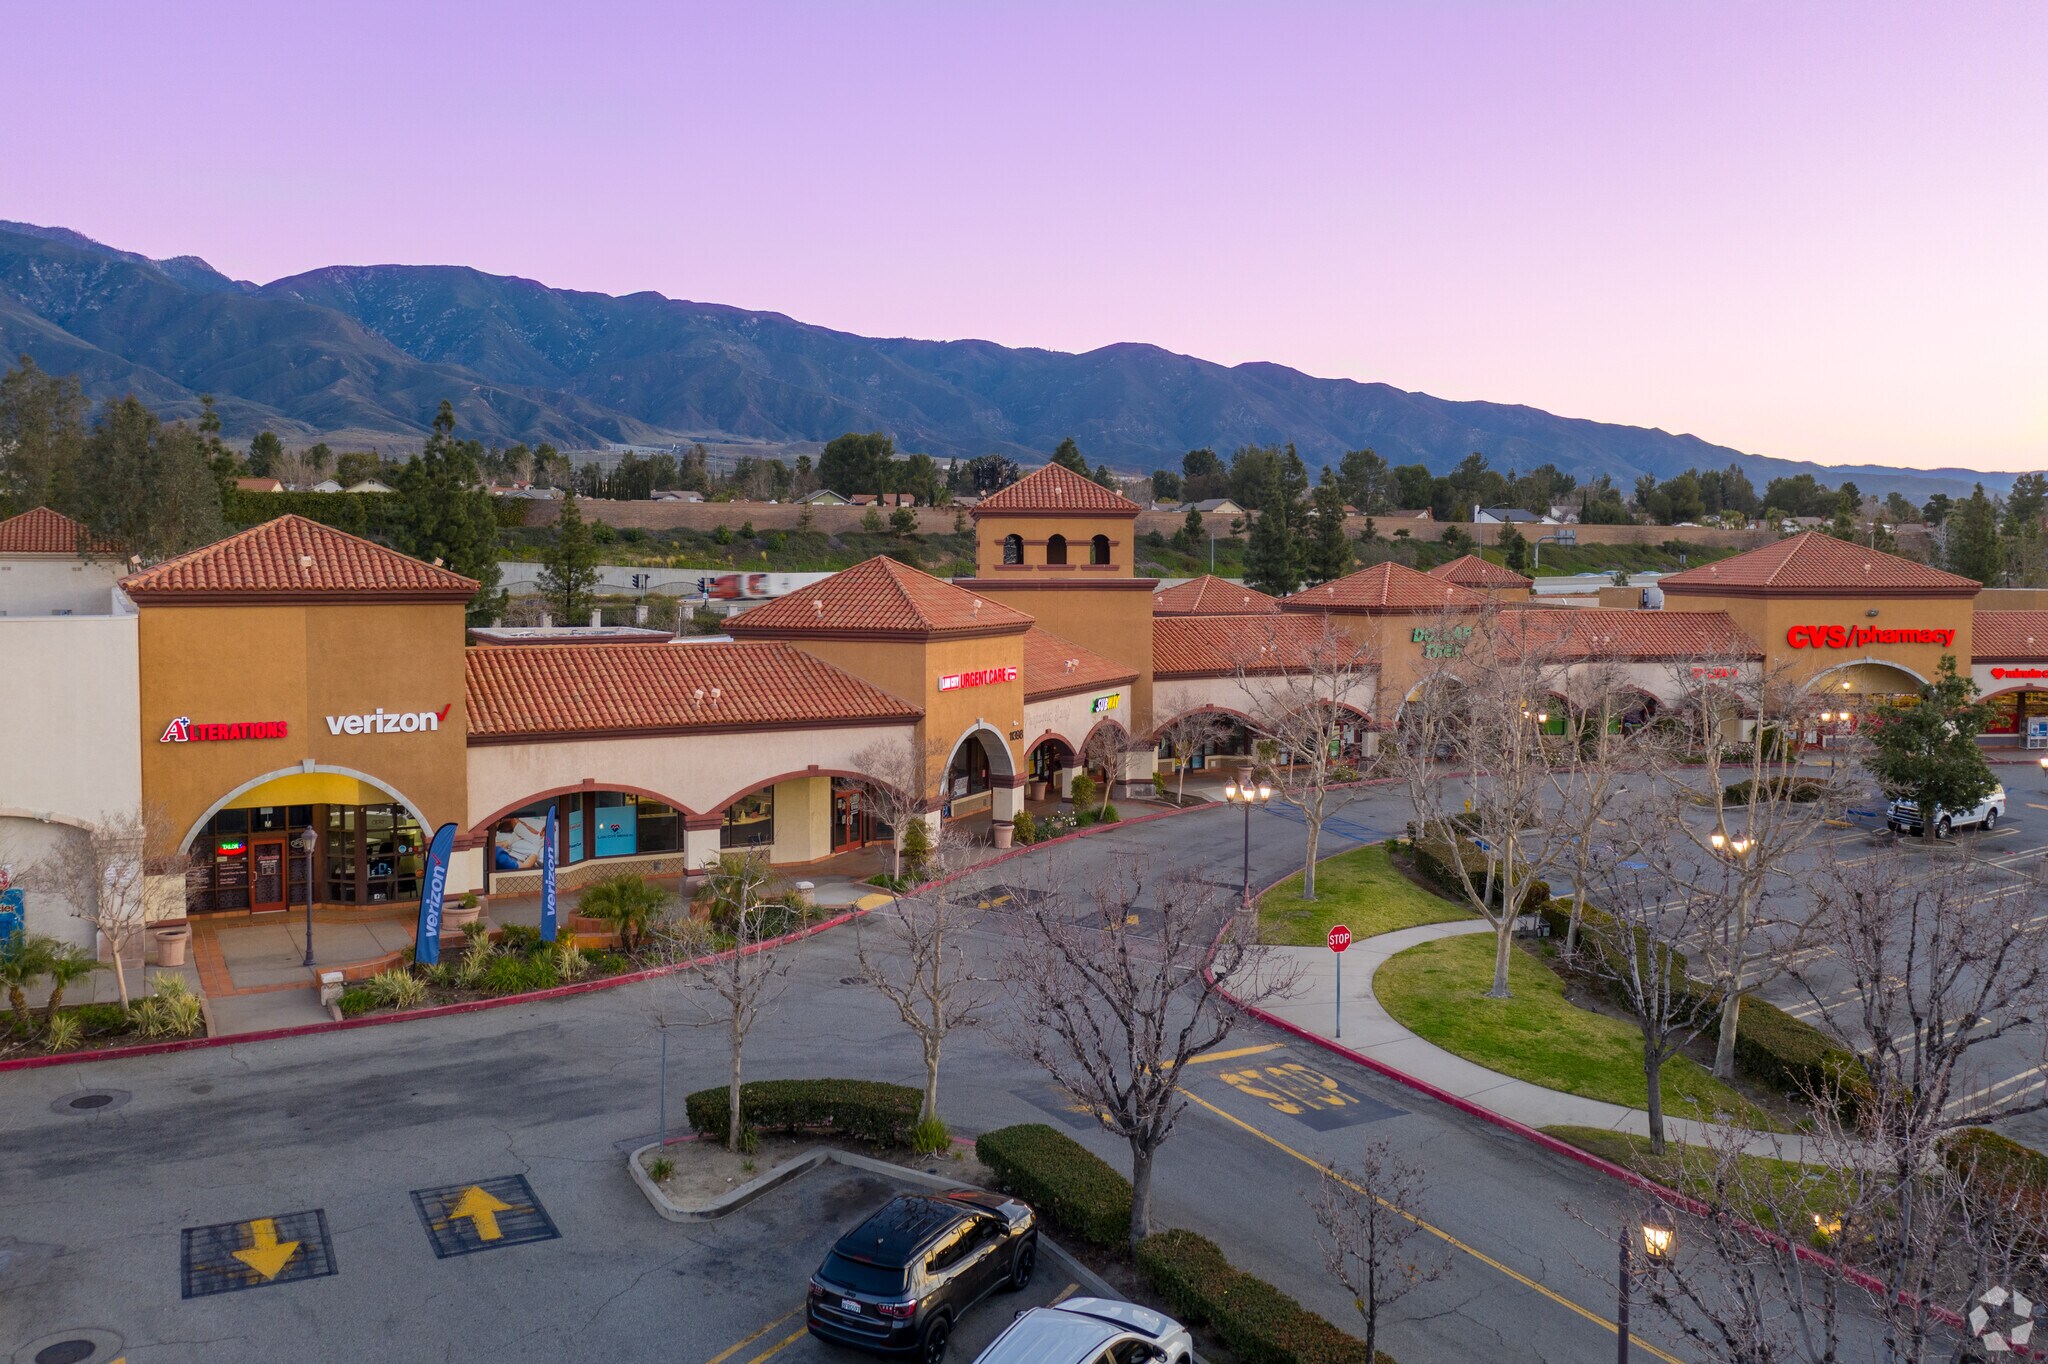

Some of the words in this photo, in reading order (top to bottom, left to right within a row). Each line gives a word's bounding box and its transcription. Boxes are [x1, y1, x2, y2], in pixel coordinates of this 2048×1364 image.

[1787, 625, 1956, 649] CVS/pharmacy
[960, 670, 988, 689] URGENT
[988, 667, 1006, 684] CARE
[1095, 694, 1121, 712] SUBWAY
[325, 707, 438, 735] verizon
[545, 846, 556, 917] verizon
[426, 865, 446, 938] verizon
[1329, 933, 1350, 945] STOP
